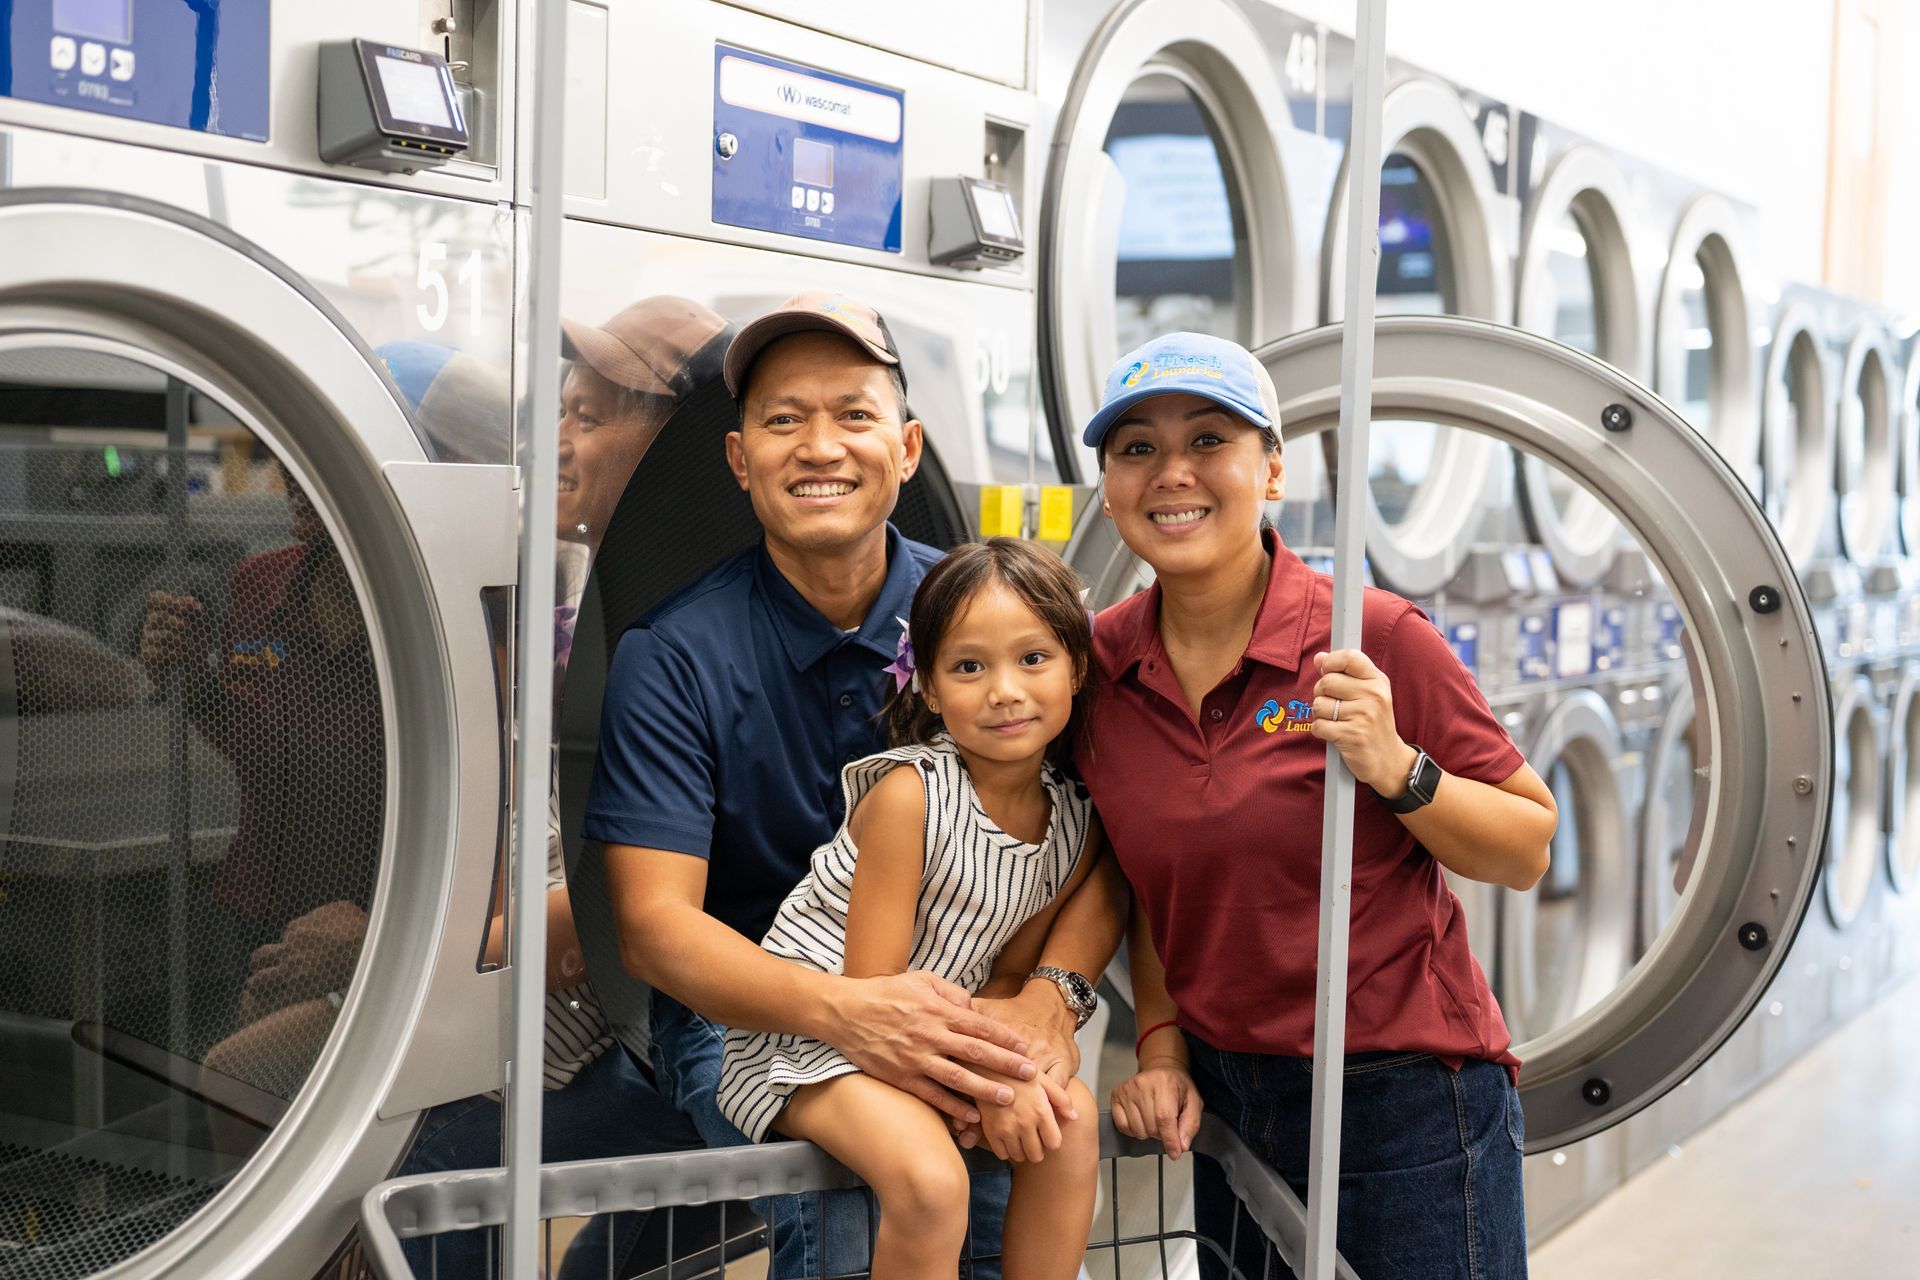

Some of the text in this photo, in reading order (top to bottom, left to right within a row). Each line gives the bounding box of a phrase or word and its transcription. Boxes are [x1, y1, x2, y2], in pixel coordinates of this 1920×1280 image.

[386, 47, 422, 62] FASCARD
[804, 95, 852, 115] wascomat
[416, 241, 482, 337] 51
[1153, 351, 1222, 369] Fresh
[1286, 697, 1313, 720] Fr
[1285, 720, 1313, 732] Laun
